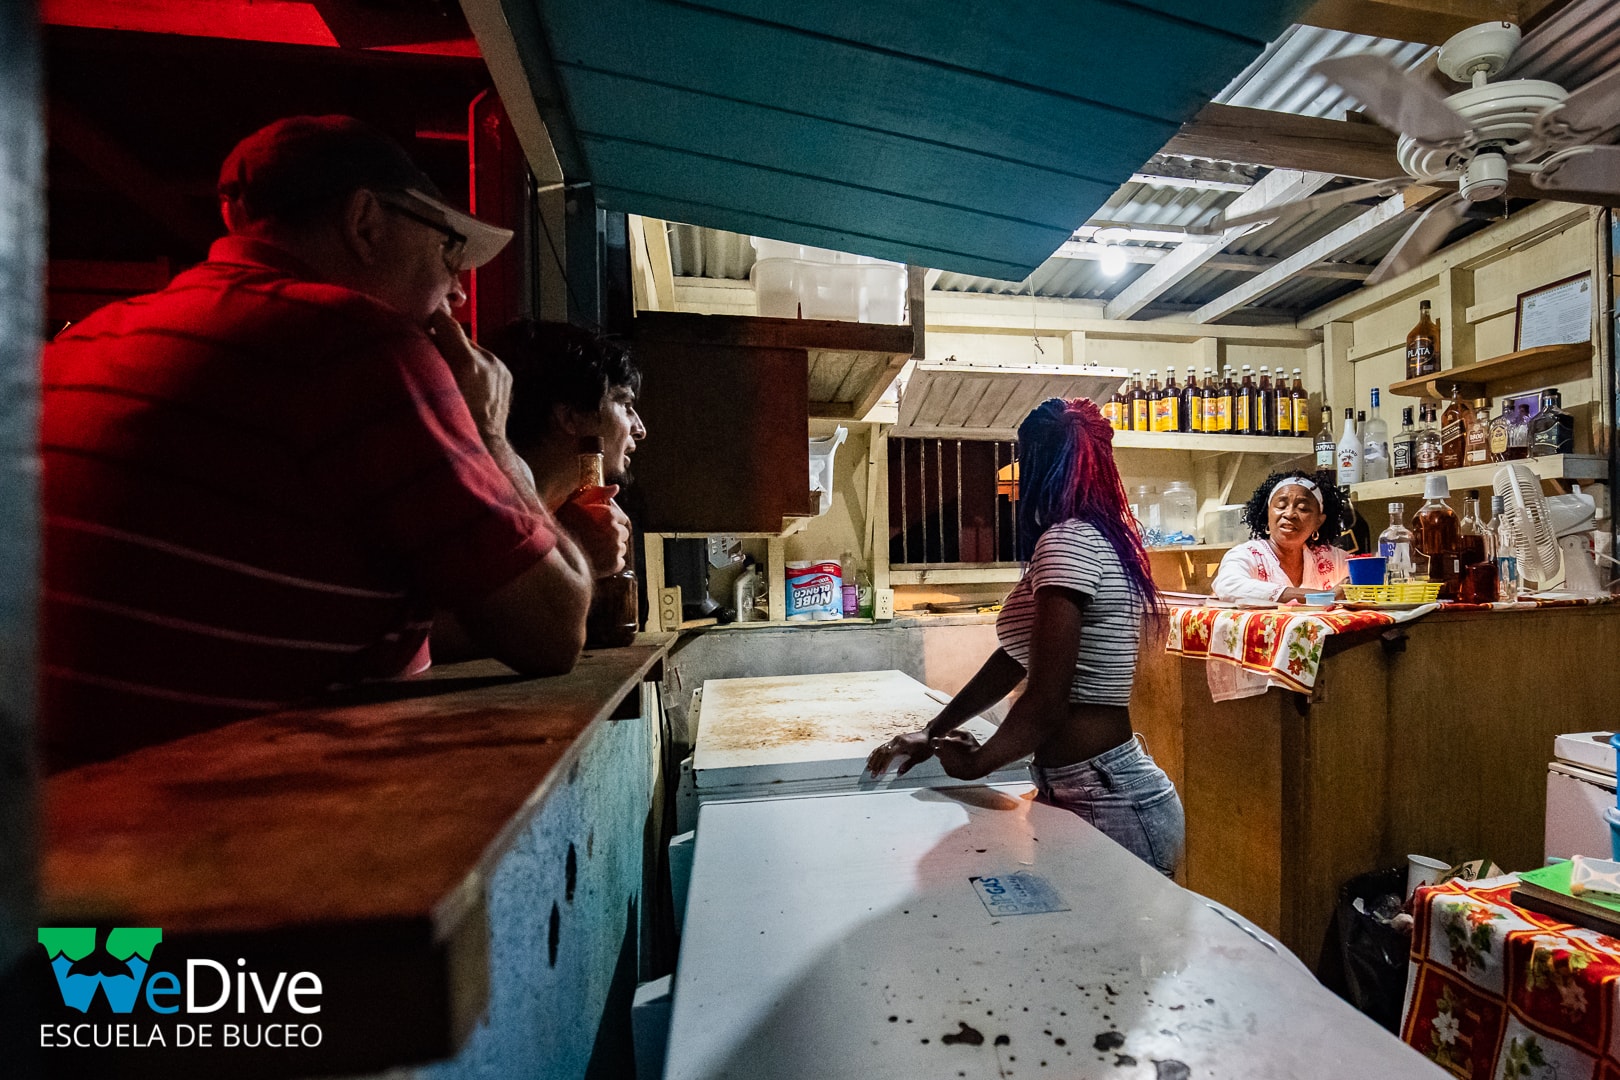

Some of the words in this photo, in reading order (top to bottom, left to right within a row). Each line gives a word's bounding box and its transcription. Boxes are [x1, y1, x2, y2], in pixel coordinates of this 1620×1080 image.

[1408, 347, 1430, 358] PLATA
[793, 584, 831, 598] BLANCA
[794, 590, 832, 609] NUBE
